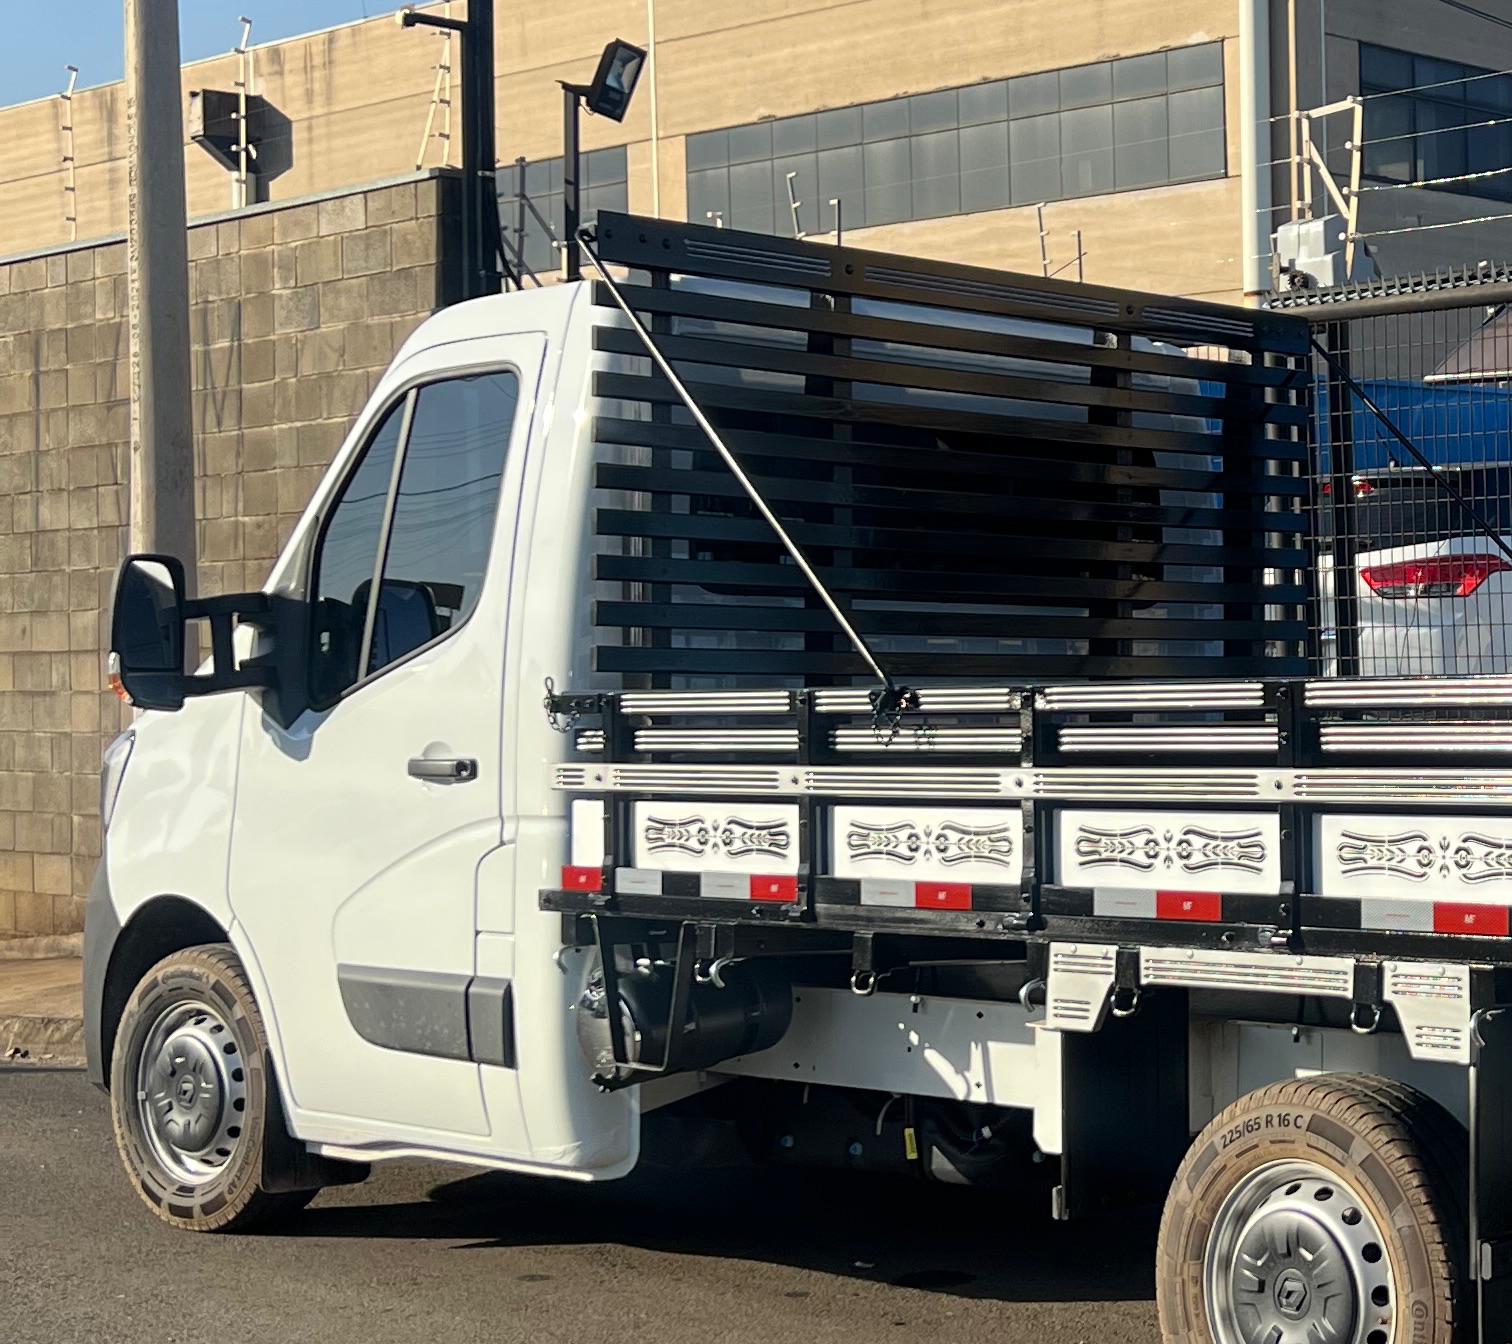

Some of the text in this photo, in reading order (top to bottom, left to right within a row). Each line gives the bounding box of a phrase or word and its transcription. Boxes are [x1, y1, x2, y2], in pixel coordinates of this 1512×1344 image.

[1220, 1113, 1304, 1149] 225/65 R 16 C
